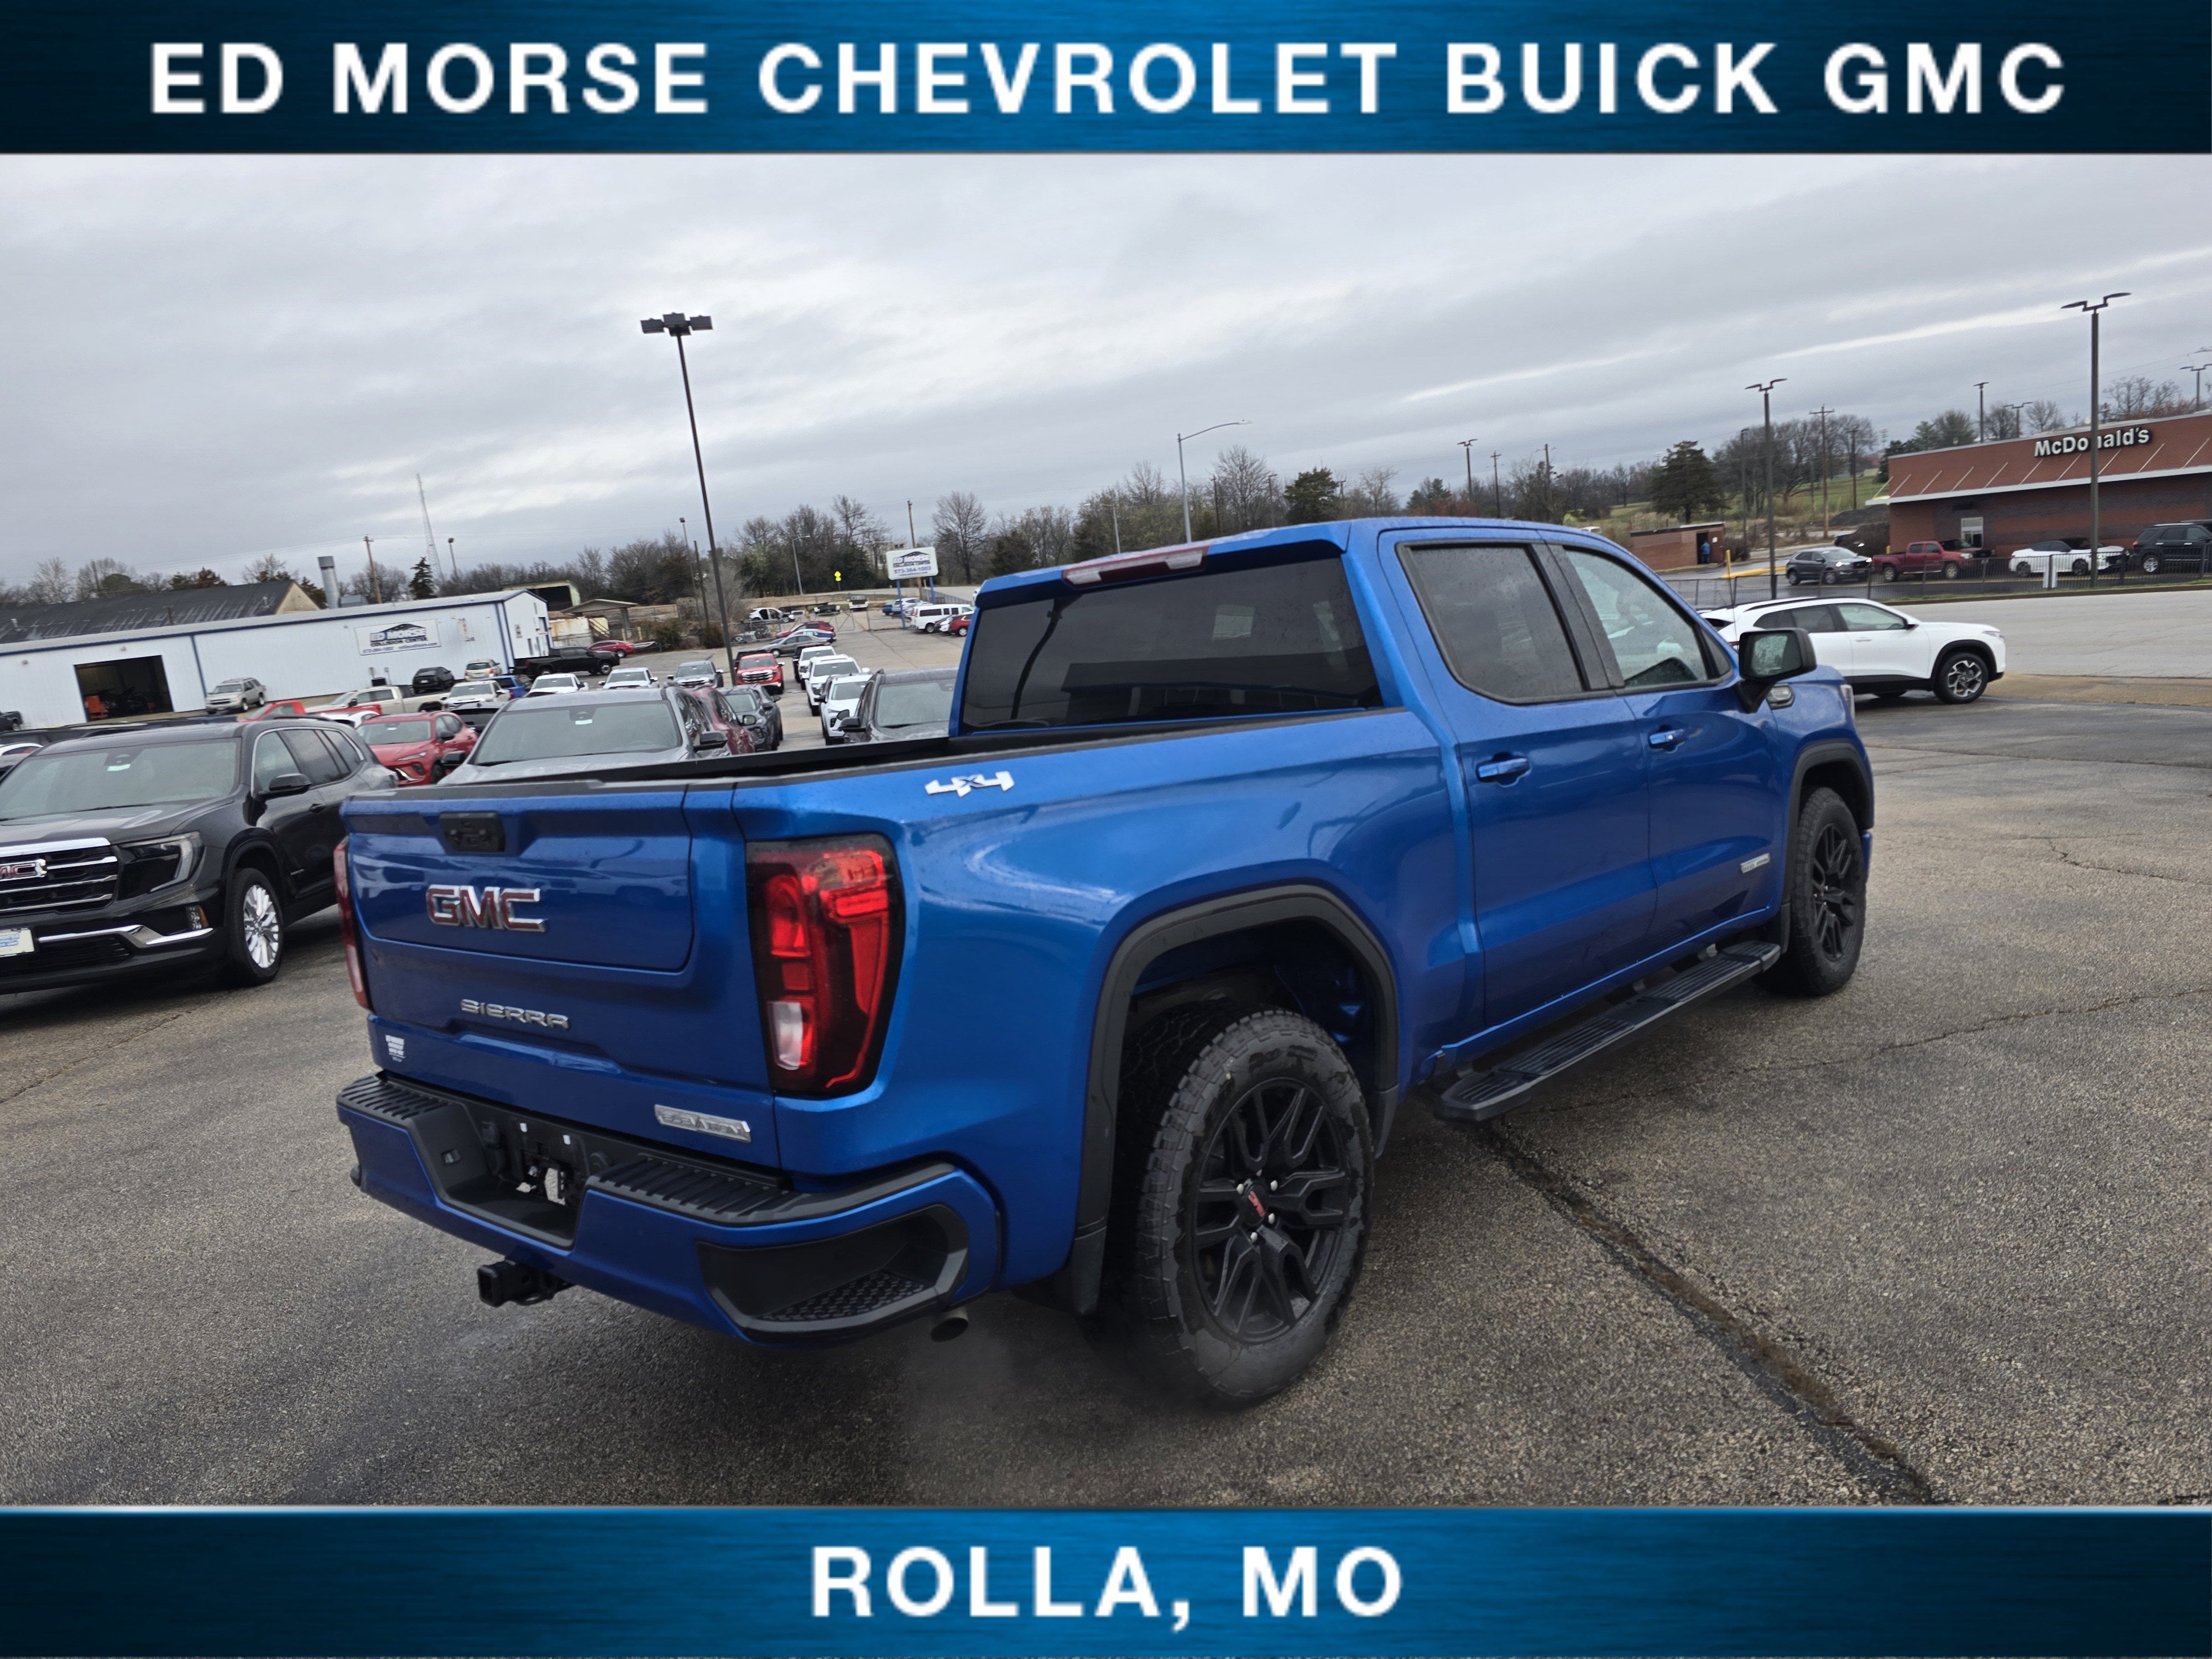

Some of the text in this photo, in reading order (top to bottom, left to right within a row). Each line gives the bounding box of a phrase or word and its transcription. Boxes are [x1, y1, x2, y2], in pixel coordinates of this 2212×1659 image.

[370, 627, 426, 643] ED MORSE
[426, 884, 546, 932] GMC
[460, 999, 571, 1030] SIERRA
